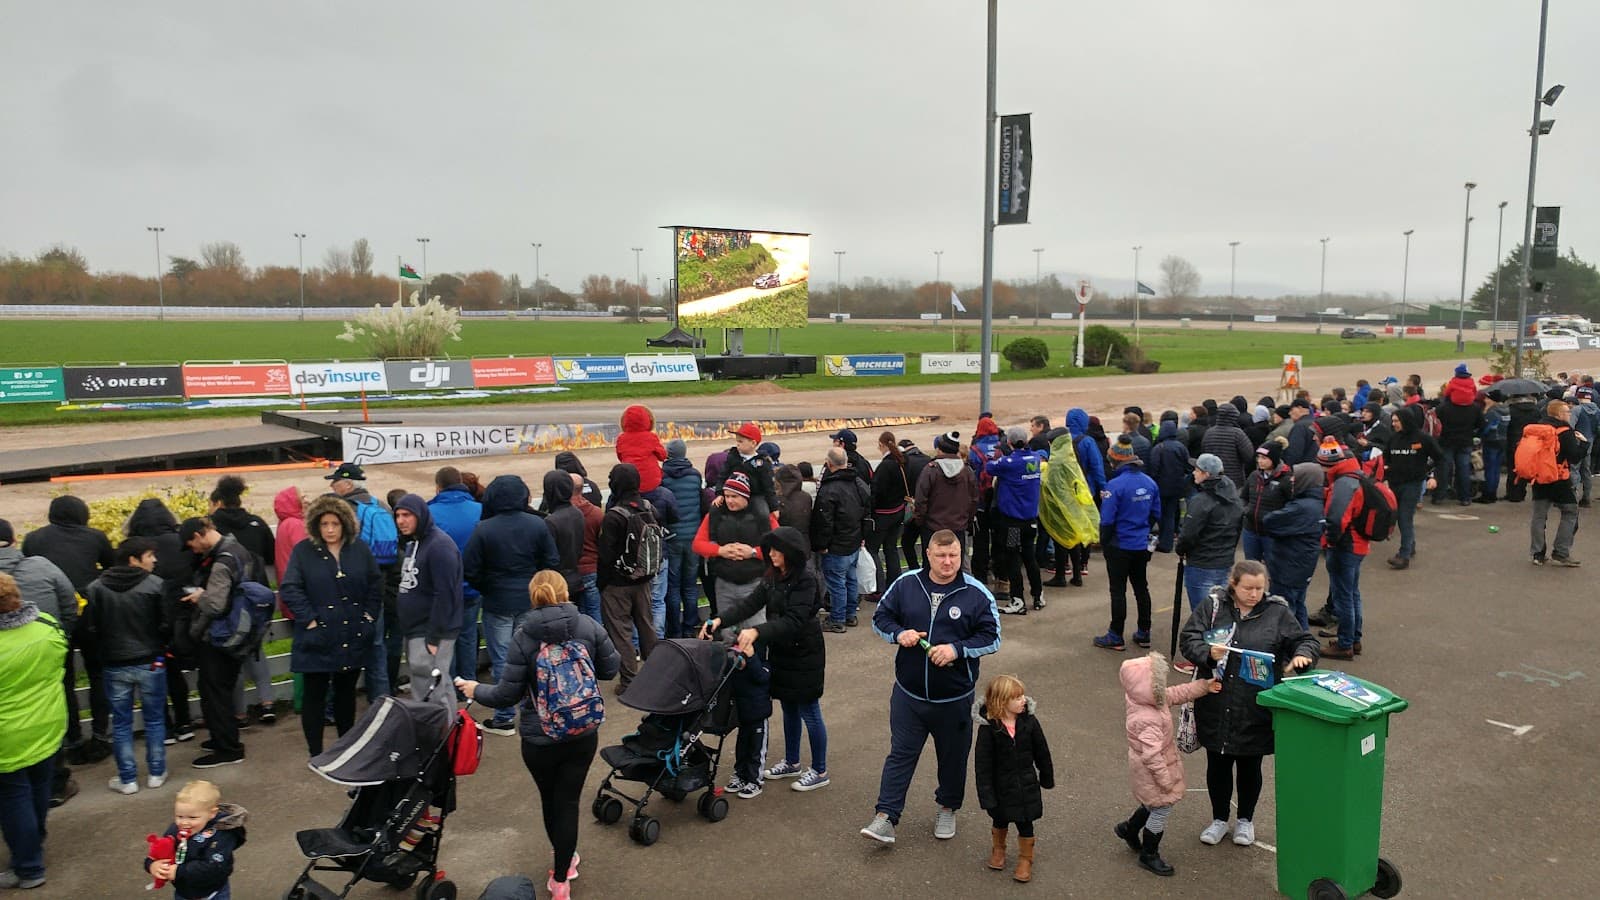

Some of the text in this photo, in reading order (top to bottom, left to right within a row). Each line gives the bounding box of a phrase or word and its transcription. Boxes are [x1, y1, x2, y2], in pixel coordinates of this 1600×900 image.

[586, 365, 625, 373] MICHELIN
[630, 362, 694, 376] dayinsure
[855, 361, 904, 369] MICHELIN
[108, 377, 168, 387] ONEBET
[295, 369, 381, 386] dayinsure
[390, 428, 517, 449] TIR PRINCE
[420, 447, 489, 458] LEISURE GROUP
